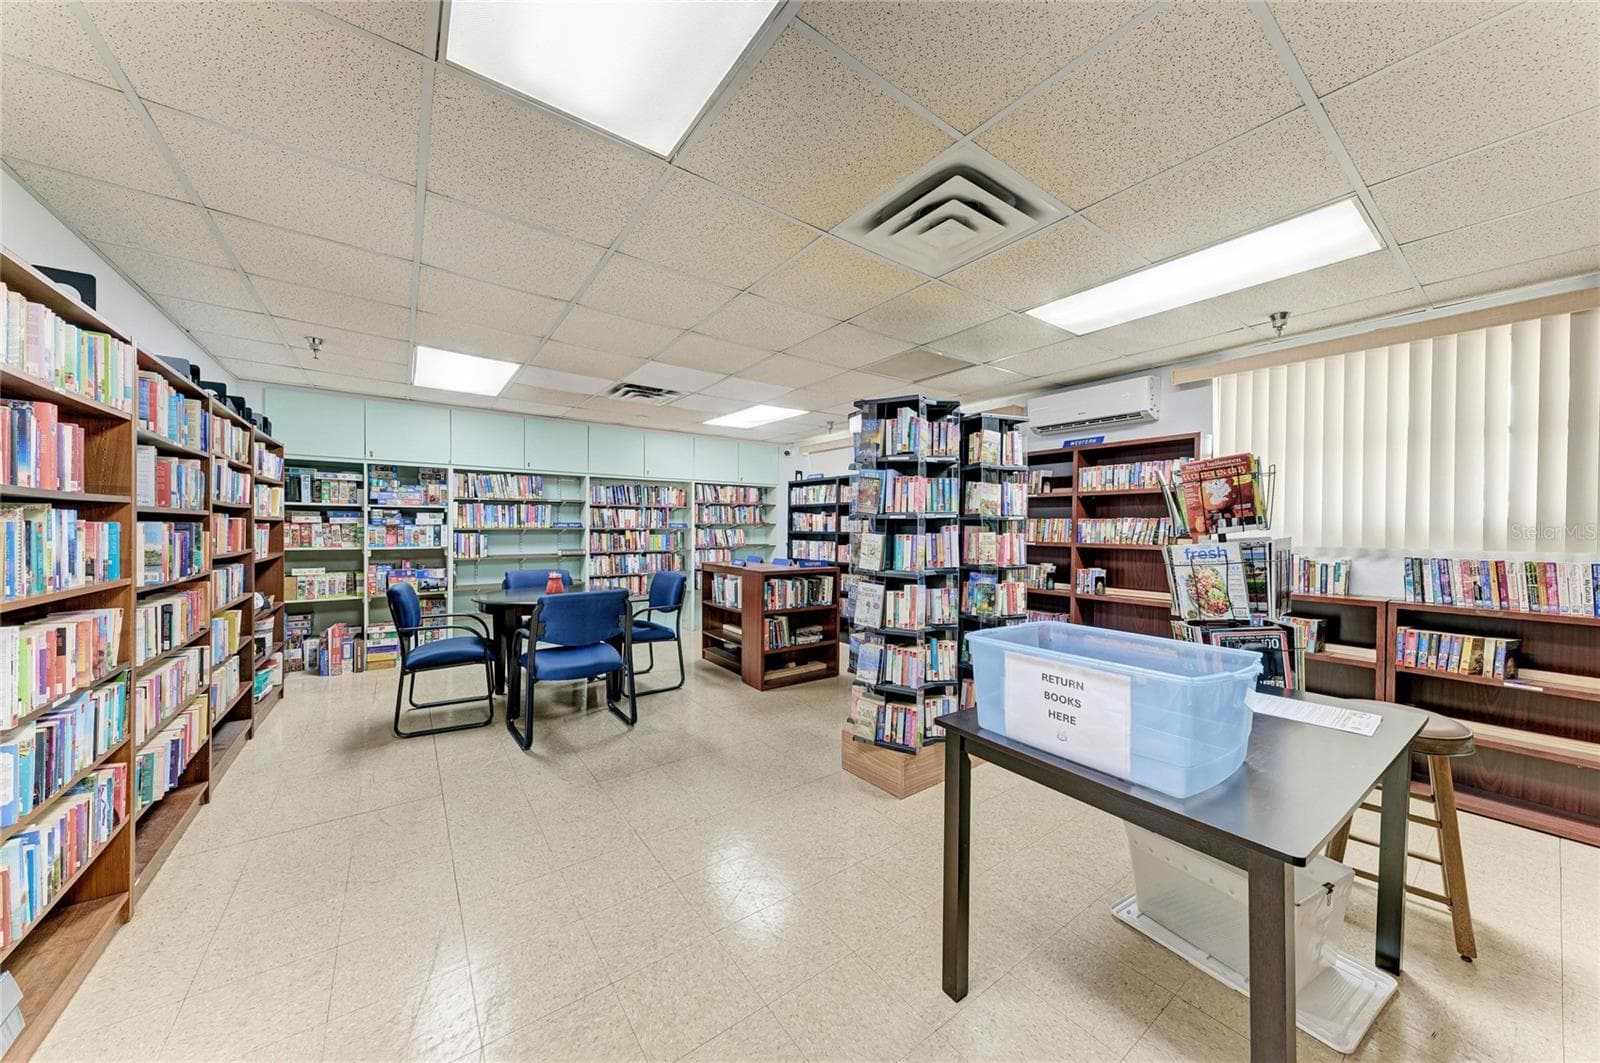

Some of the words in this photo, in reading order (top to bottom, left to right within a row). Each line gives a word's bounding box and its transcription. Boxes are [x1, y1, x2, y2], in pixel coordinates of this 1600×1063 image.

[1184, 546, 1228, 560] fresh
[1041, 673, 1084, 691] RETURN
[1044, 691, 1081, 708] BOOKS
[1048, 709, 1077, 725] HERE
